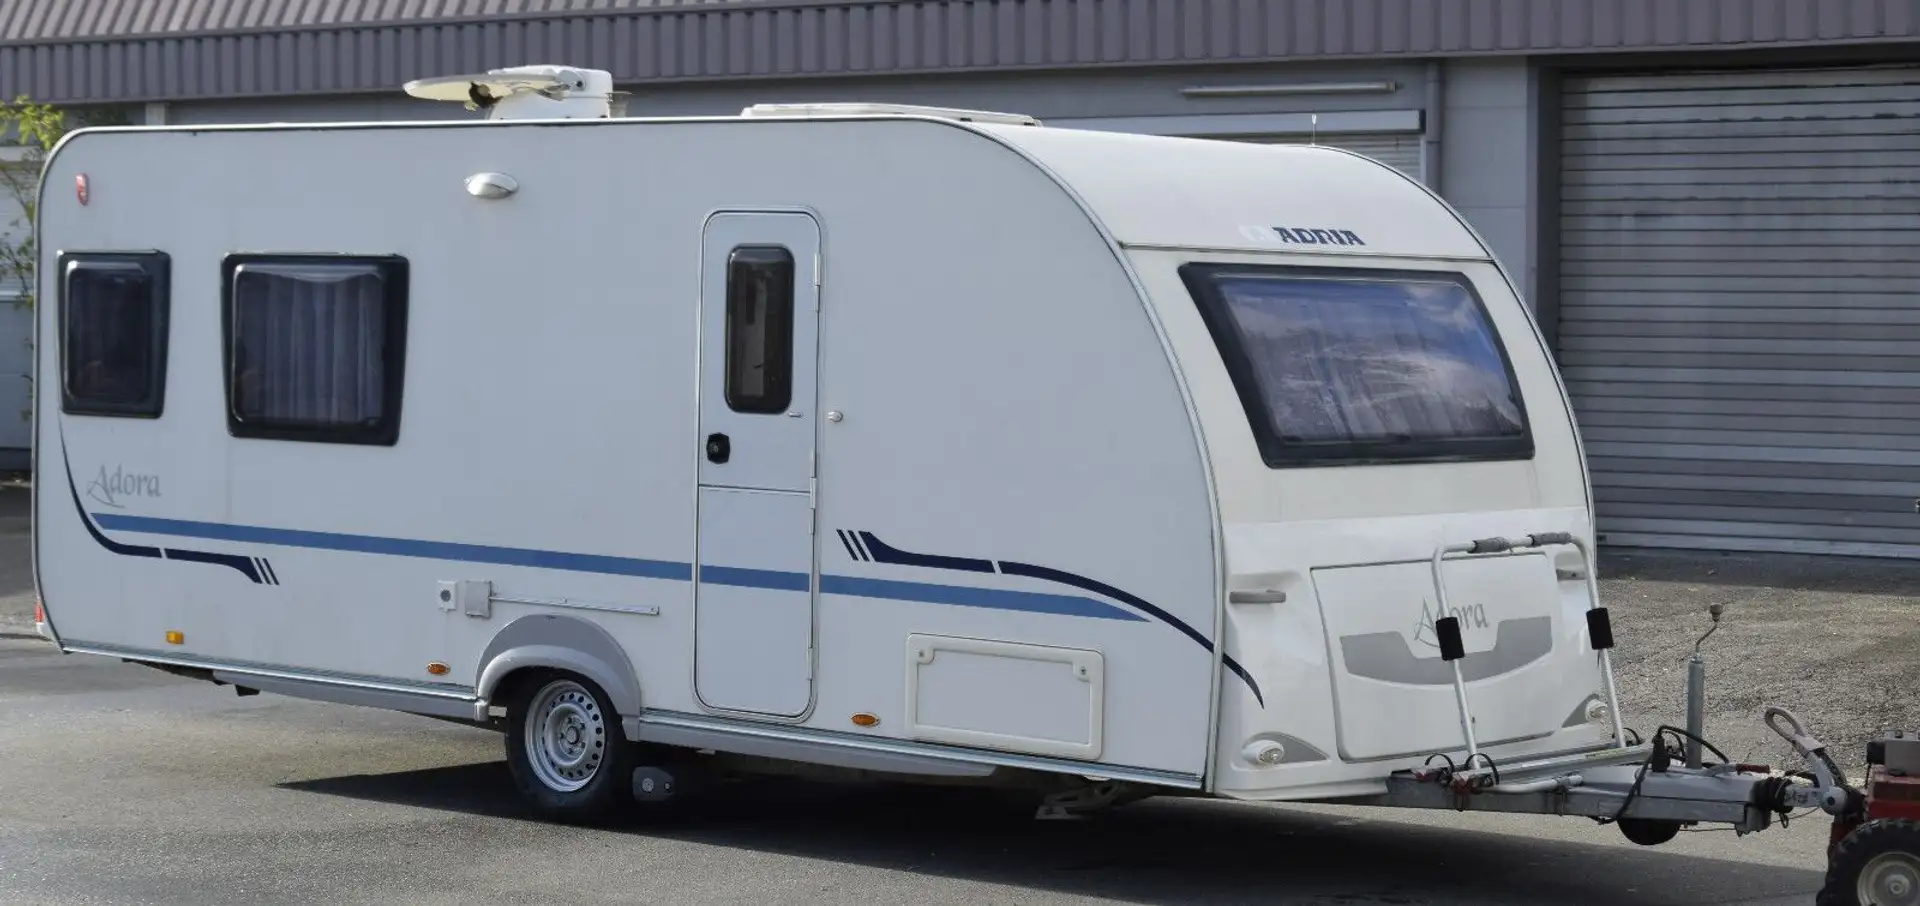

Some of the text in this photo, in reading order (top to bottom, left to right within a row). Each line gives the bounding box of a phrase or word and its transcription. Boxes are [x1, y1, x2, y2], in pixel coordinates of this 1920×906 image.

[1272, 226, 1366, 246] ADRIA
[86, 463, 163, 509] Adora
[1414, 597, 1488, 648] Aora
